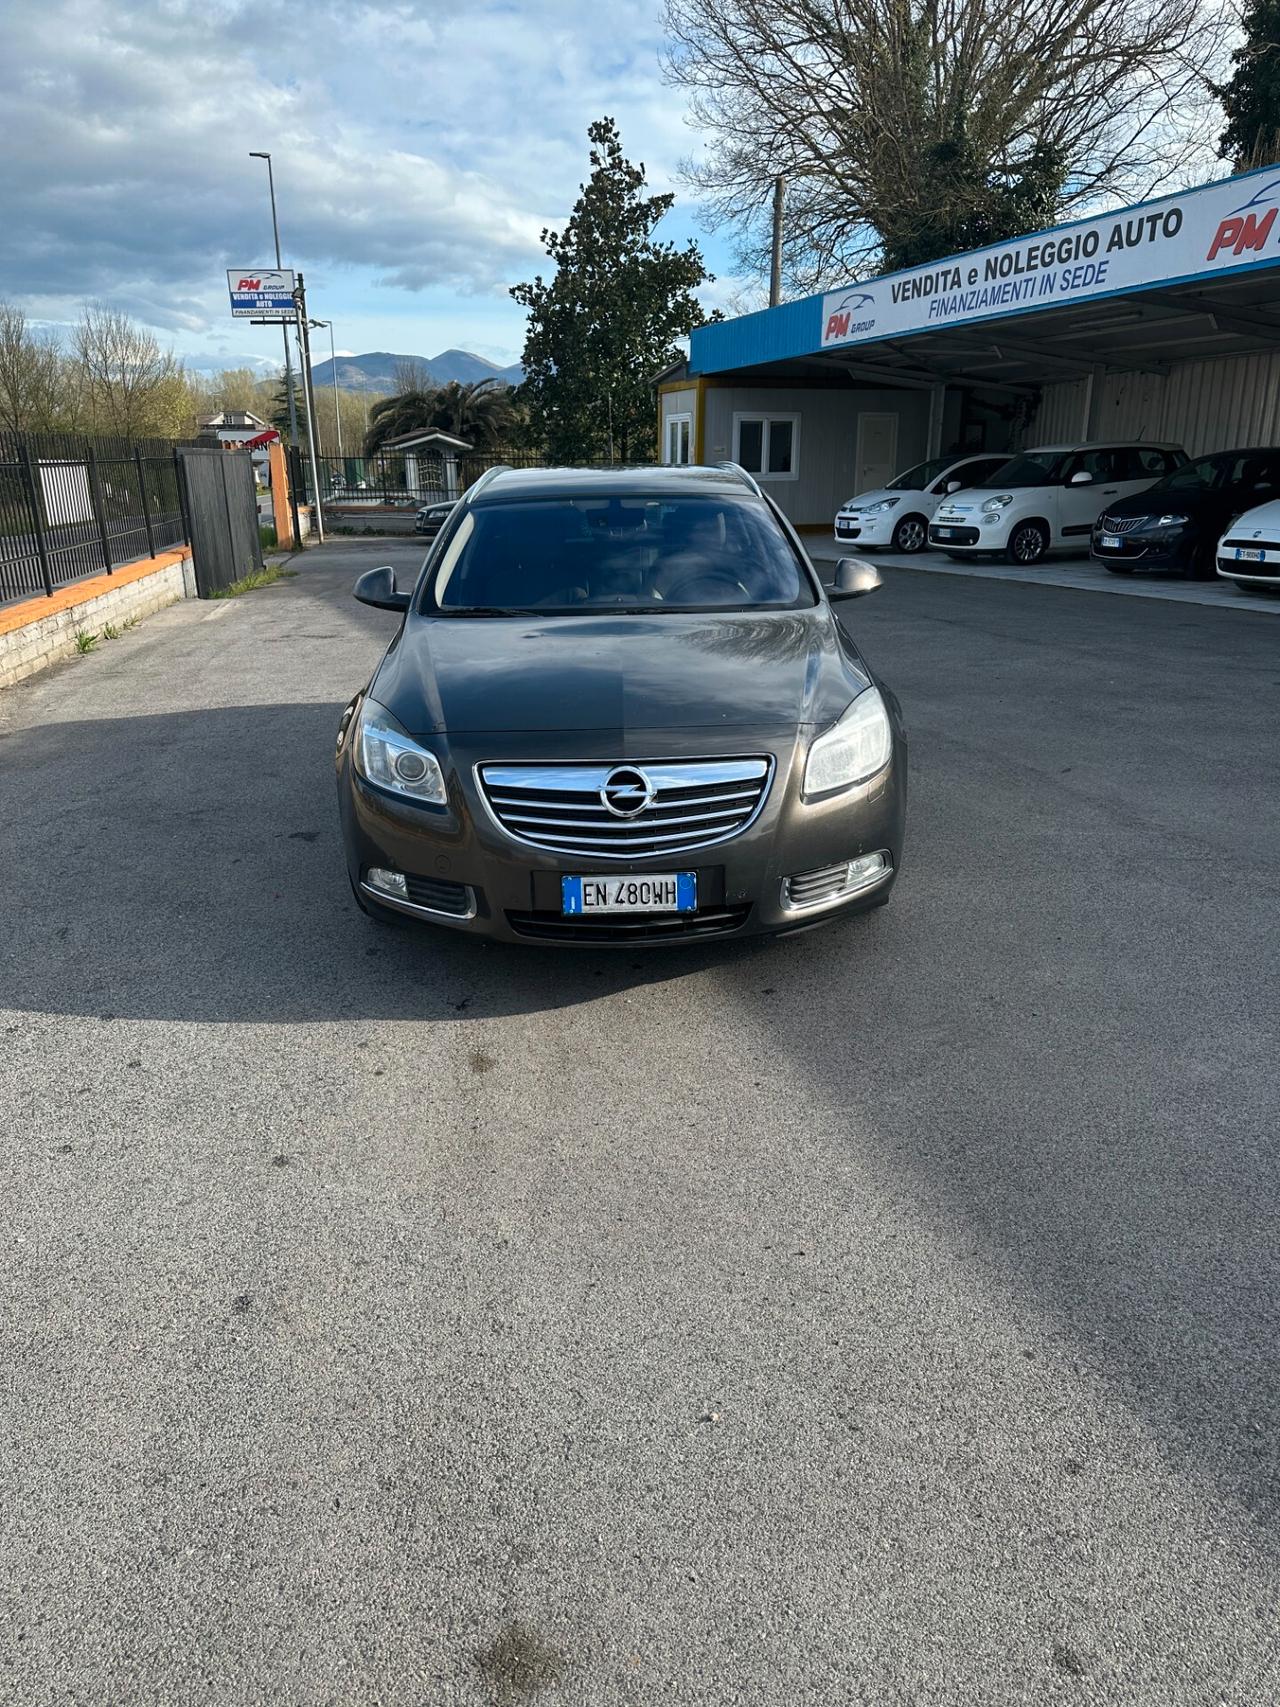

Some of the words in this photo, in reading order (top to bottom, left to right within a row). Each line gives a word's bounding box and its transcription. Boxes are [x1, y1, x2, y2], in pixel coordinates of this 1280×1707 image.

[1206, 207, 1279, 261] PM
[891, 266, 962, 304] VENDITA
[967, 272, 978, 286] e
[984, 230, 1100, 282] NOLEGGIO
[1106, 207, 1183, 253] AUTO
[238, 280, 261, 291] PM
[928, 275, 1036, 319] FINANZIAMENTI
[1039, 271, 1054, 297] IN
[1060, 260, 1110, 290] SEDE
[825, 311, 852, 341] PM
[851, 319, 876, 334] GROUP
[583, 883, 608, 906] EN
